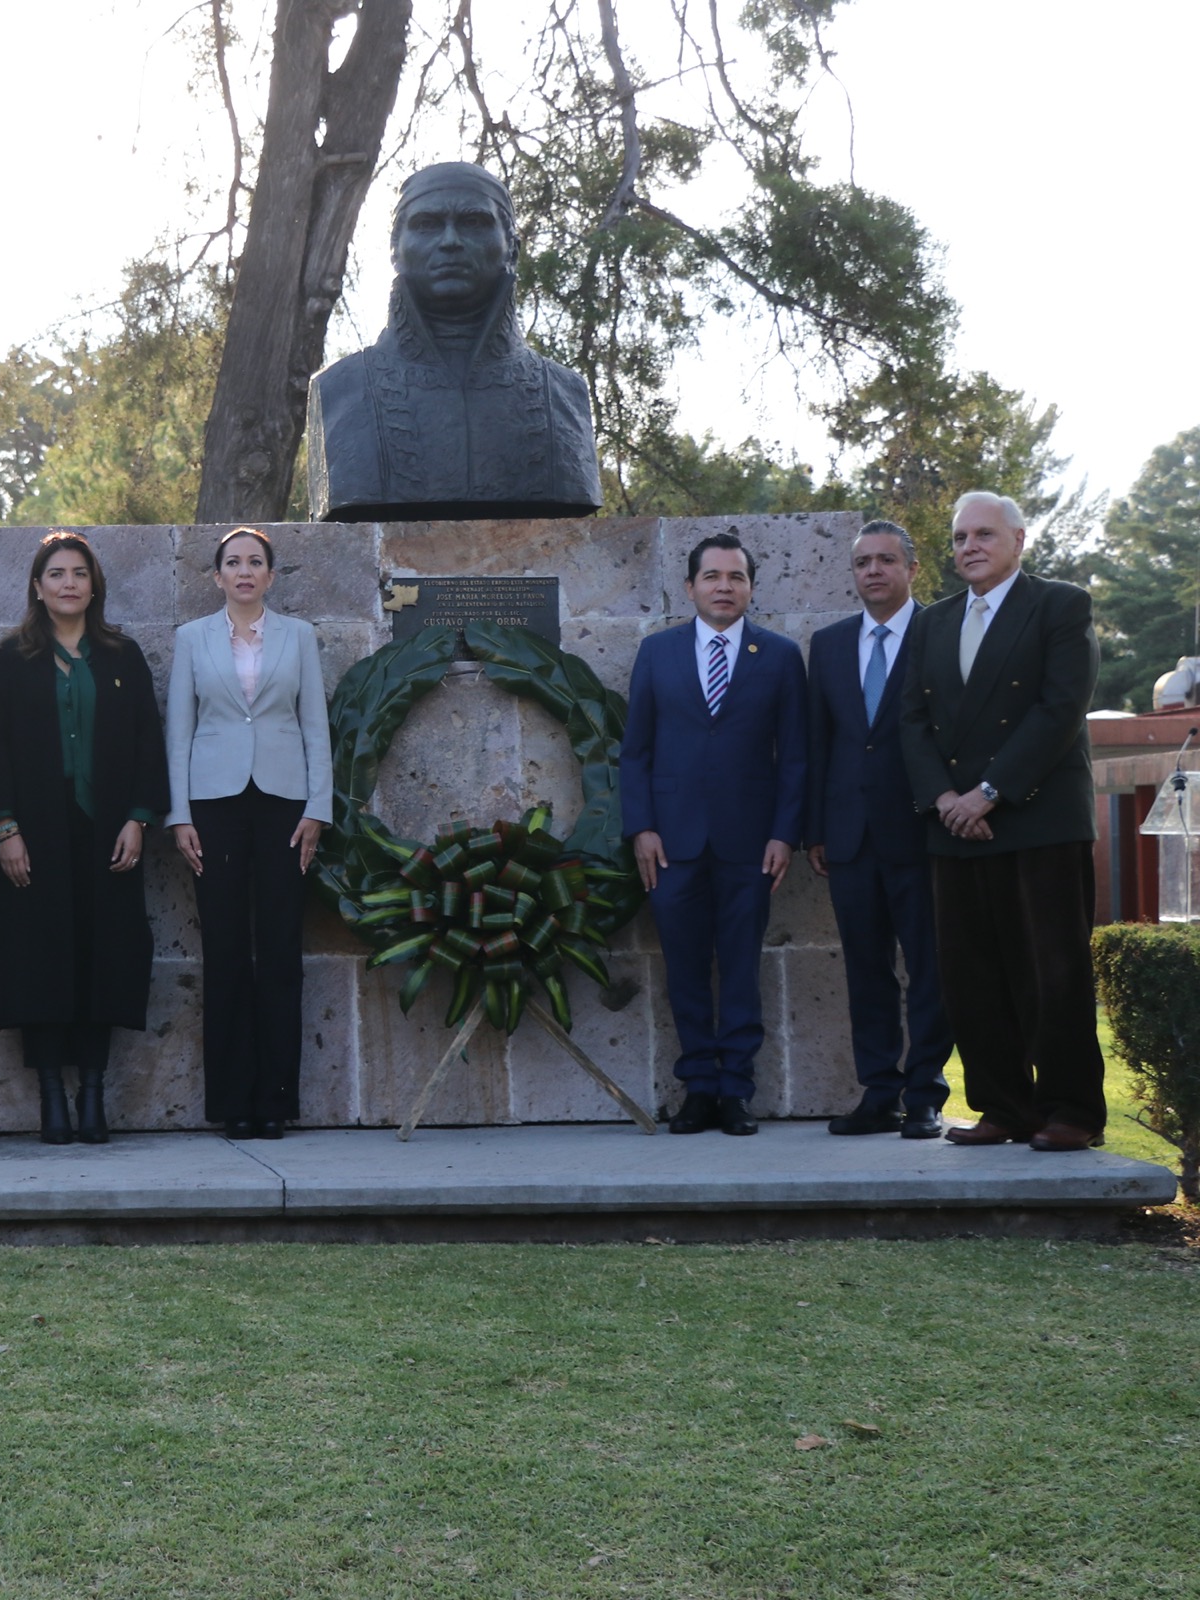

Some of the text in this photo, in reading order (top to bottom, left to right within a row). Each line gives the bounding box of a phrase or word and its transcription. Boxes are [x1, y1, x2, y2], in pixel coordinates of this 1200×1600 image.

[436, 593, 453, 601] JOSE
[455, 593, 478, 601] MARIA
[423, 617, 464, 626] GUSTAVO
[496, 617, 529, 626] ORDAZ
